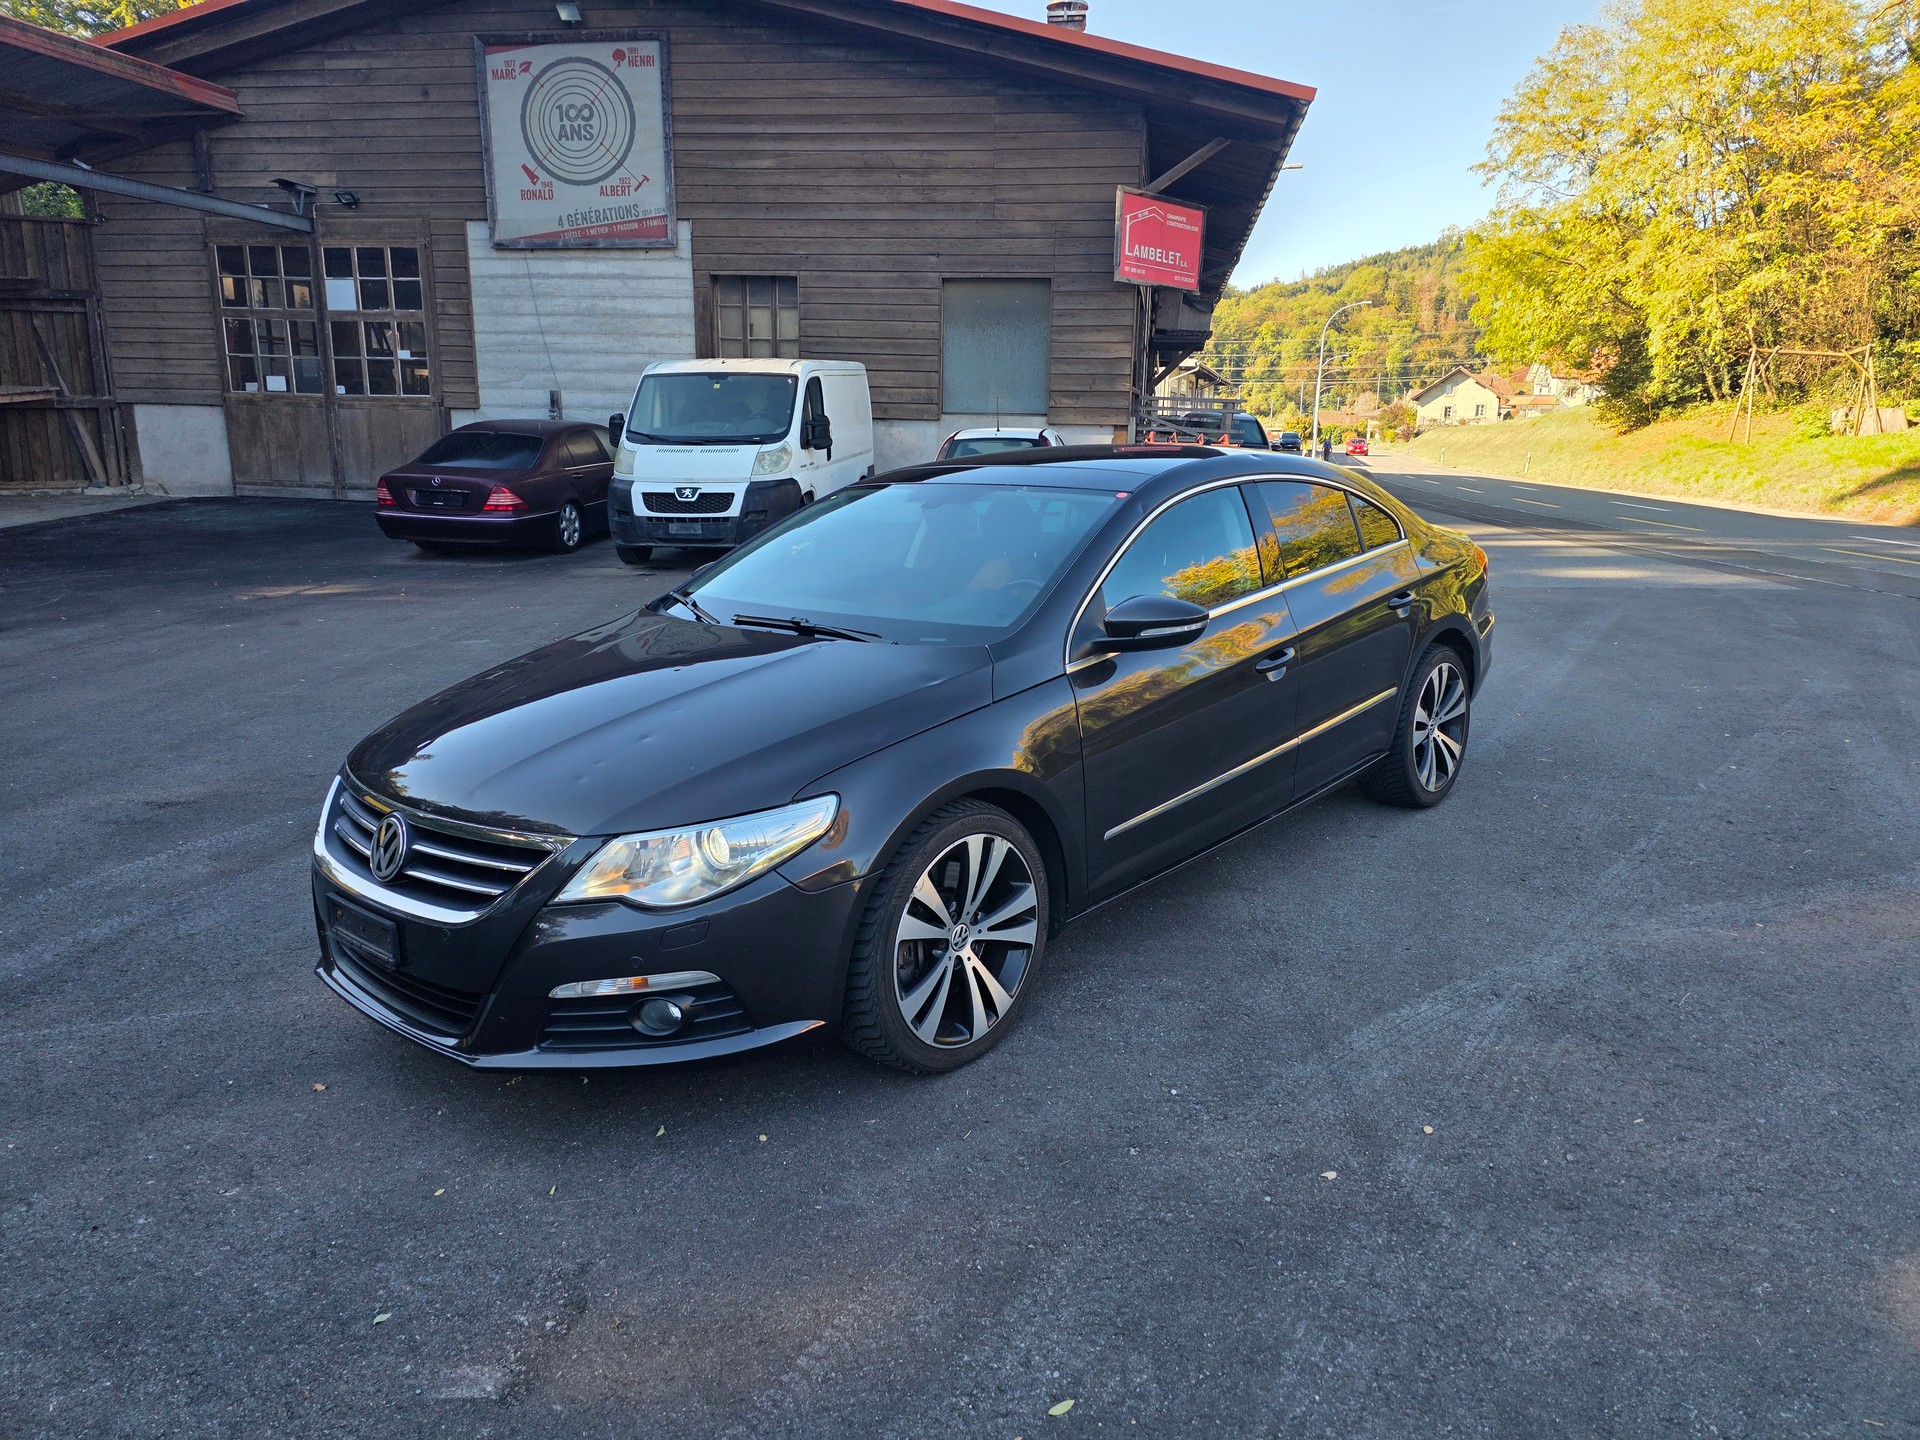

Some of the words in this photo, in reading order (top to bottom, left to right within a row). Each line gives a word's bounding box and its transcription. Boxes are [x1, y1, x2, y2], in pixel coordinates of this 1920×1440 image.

[628, 55, 654, 67] HENRI
[492, 68, 516, 80] MARC
[558, 124, 594, 142] ANS
[520, 189, 554, 200] RONALD
[600, 185, 632, 196] ALBERT
[558, 215, 564, 228] 4
[566, 204, 640, 227] GÉNÉRATIONS
[617, 222, 638, 232] PASSION
[646, 218, 668, 227] FAMILLE
